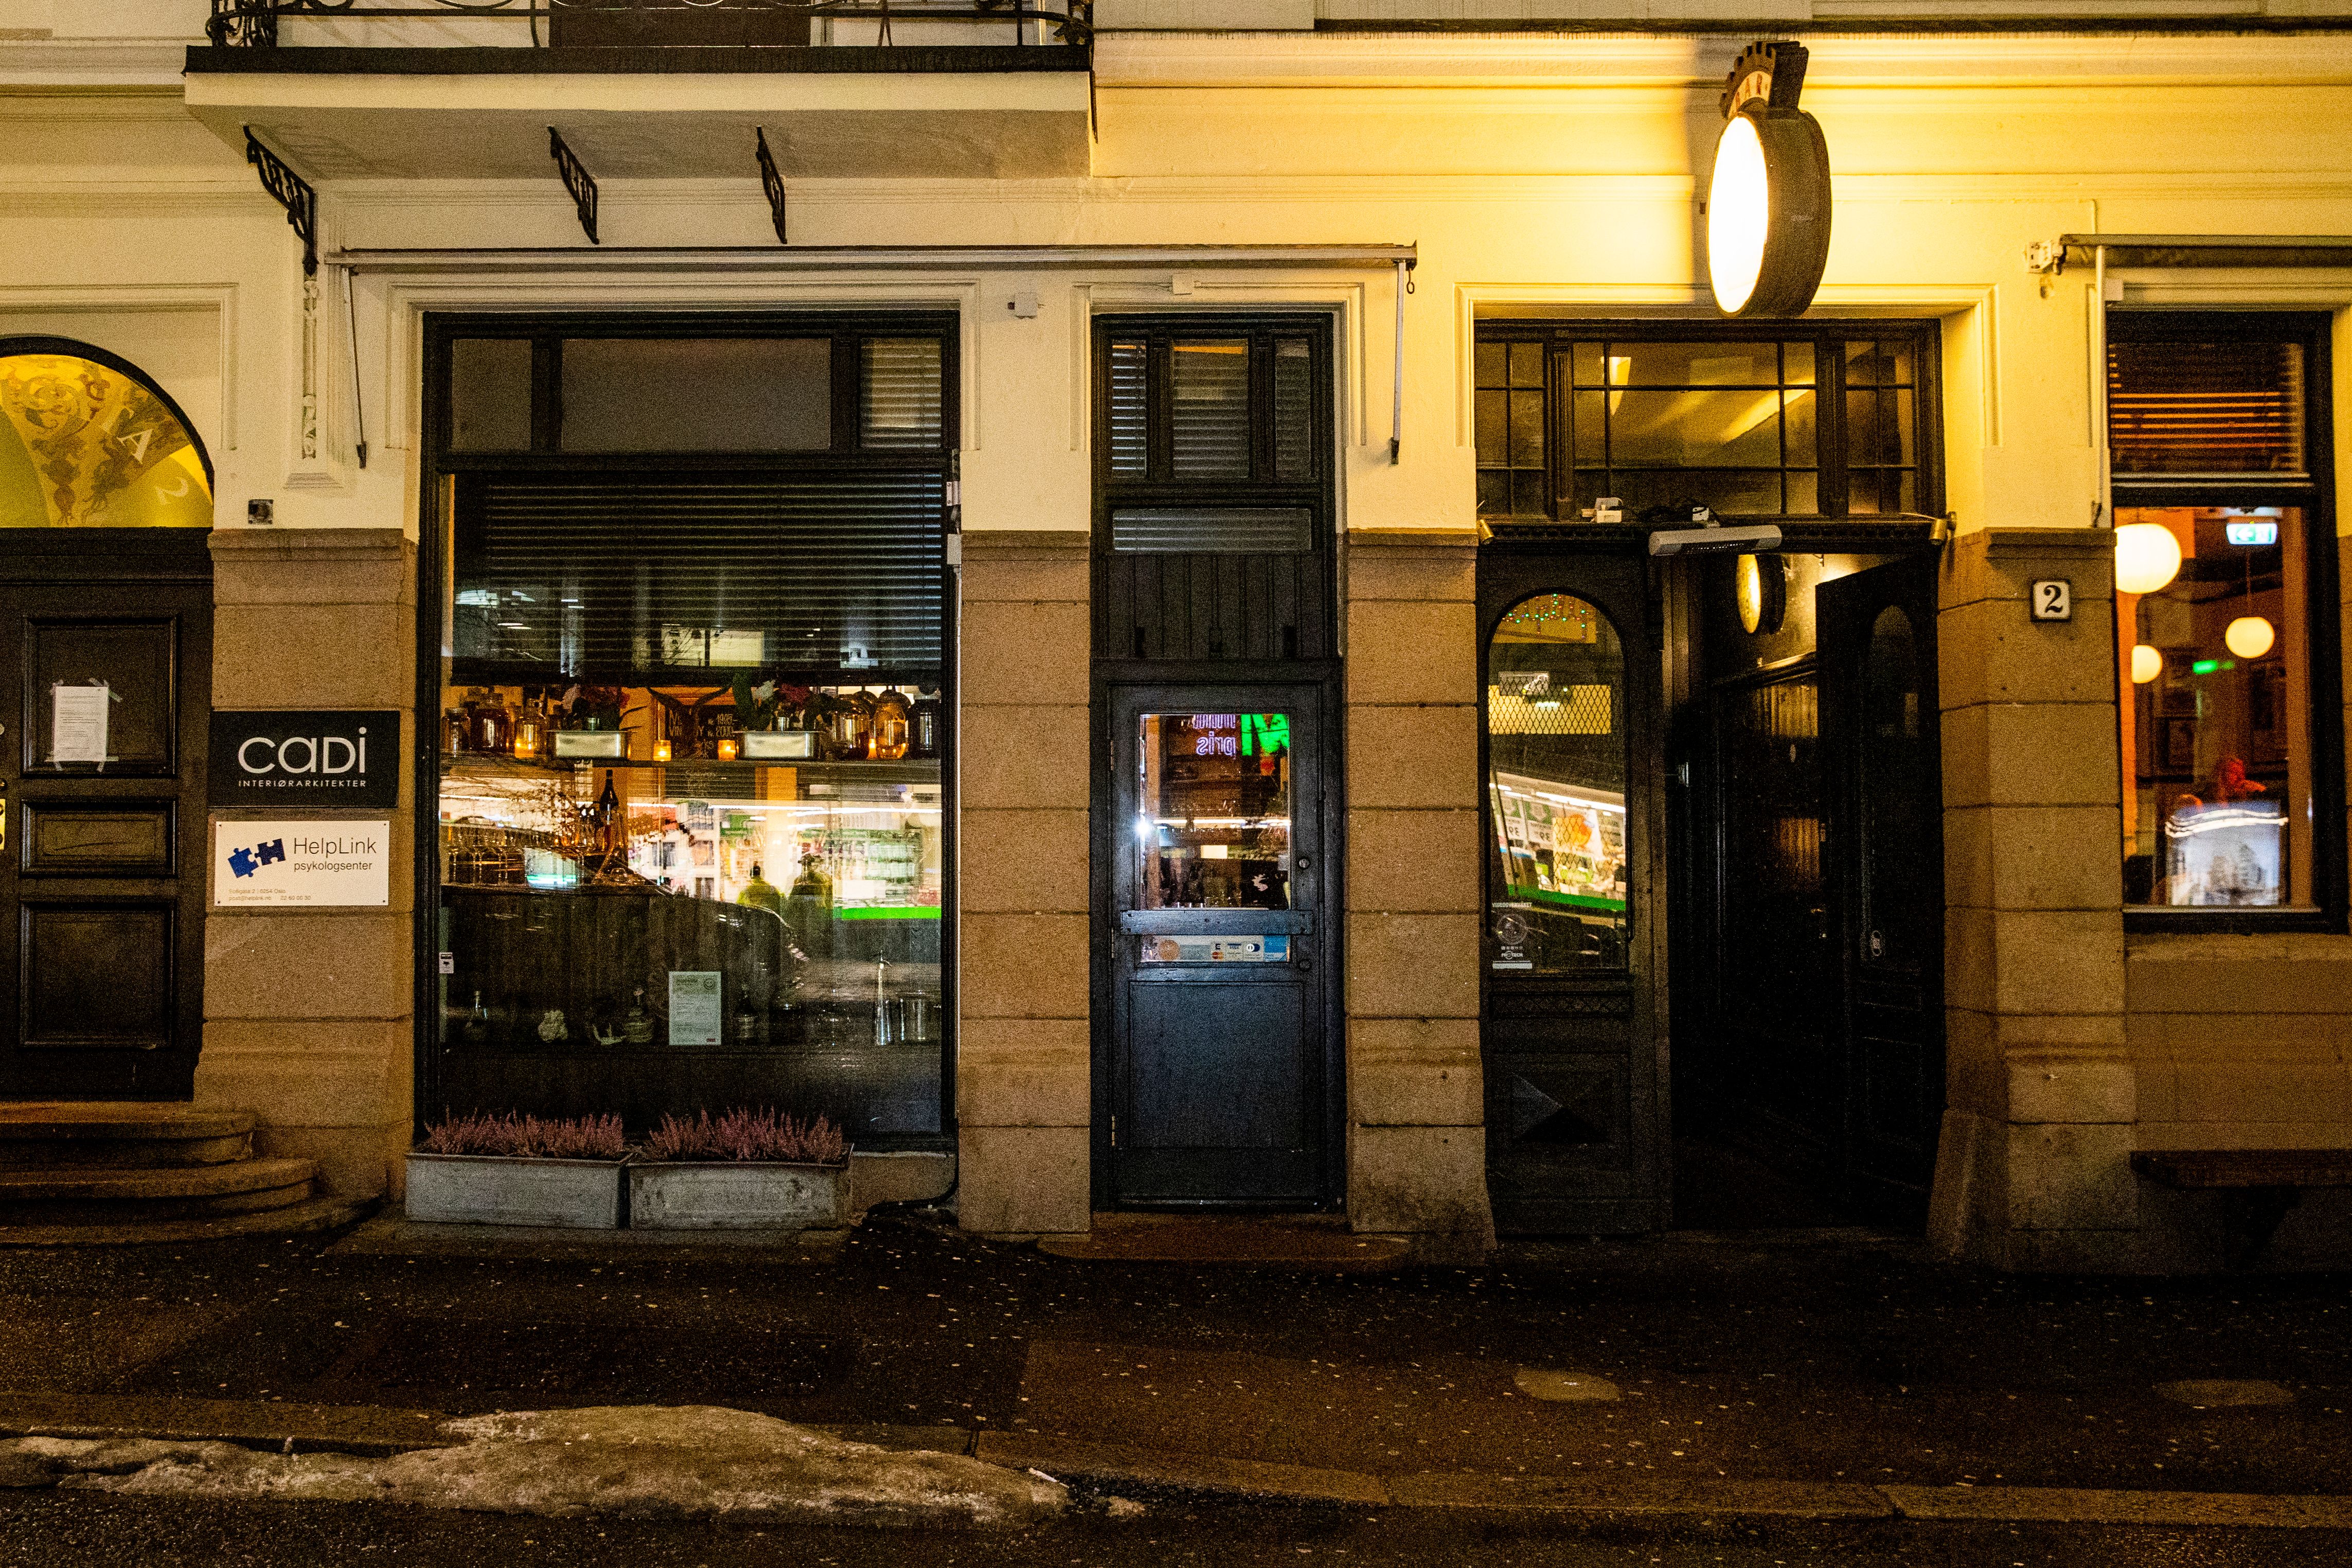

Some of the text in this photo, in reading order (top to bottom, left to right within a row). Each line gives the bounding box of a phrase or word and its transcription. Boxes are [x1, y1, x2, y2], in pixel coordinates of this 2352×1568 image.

[2043, 584, 2063, 613] 2
[294, 837, 377, 859] HelpLink
[294, 861, 372, 872] psykologsenter
